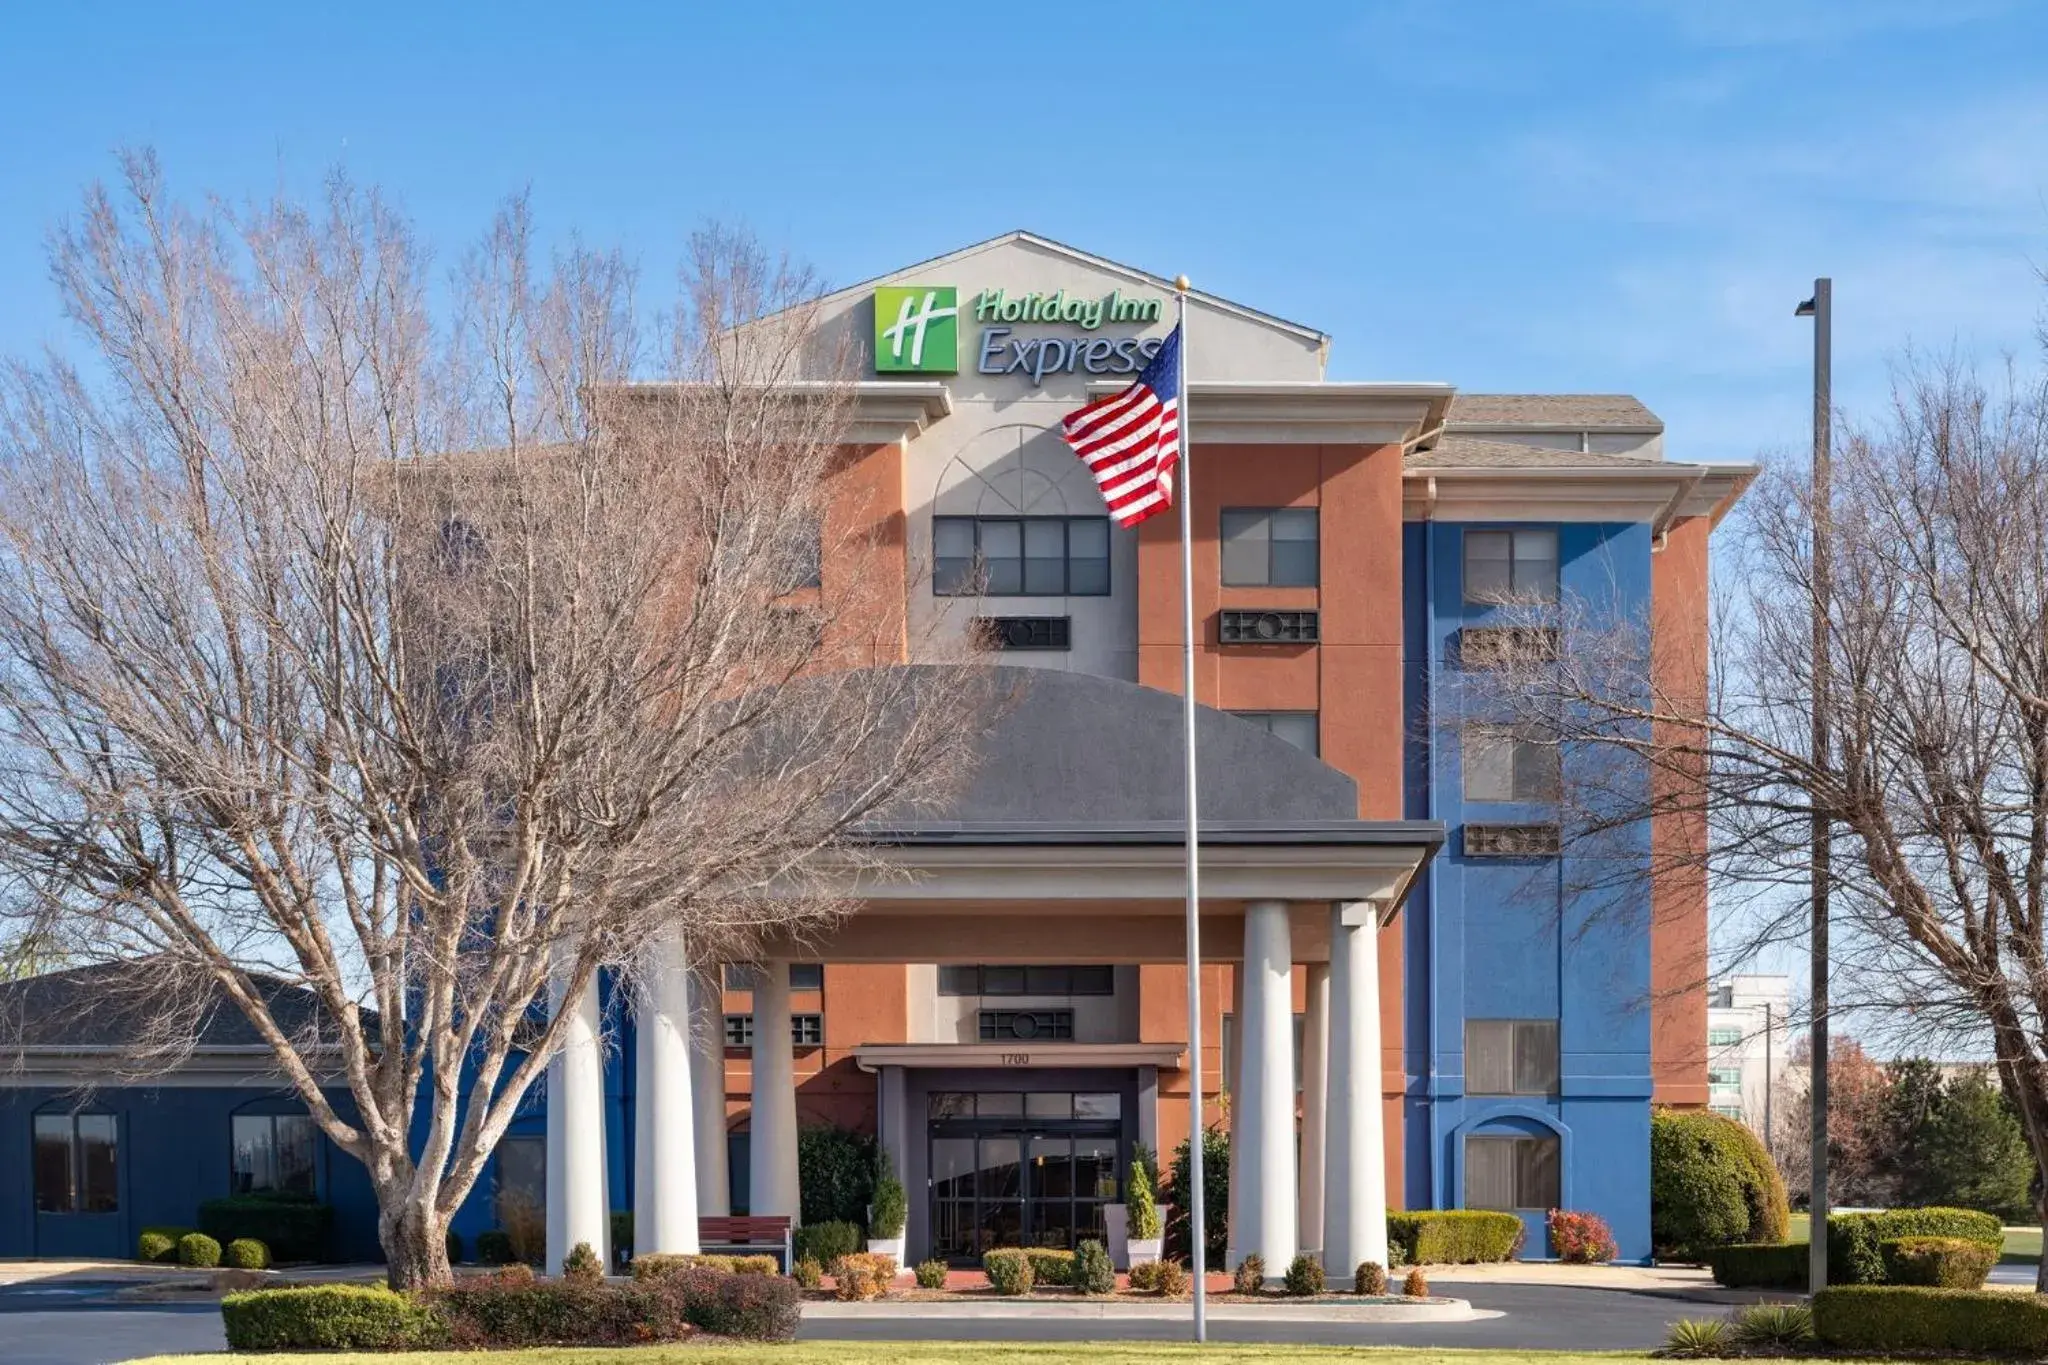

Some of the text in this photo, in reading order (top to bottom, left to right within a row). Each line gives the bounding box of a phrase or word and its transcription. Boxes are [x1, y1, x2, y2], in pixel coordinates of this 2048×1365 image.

[883, 292, 957, 365] H
[976, 287, 1162, 329] Holiday Inn
[1001, 1053, 1030, 1065] 1700
